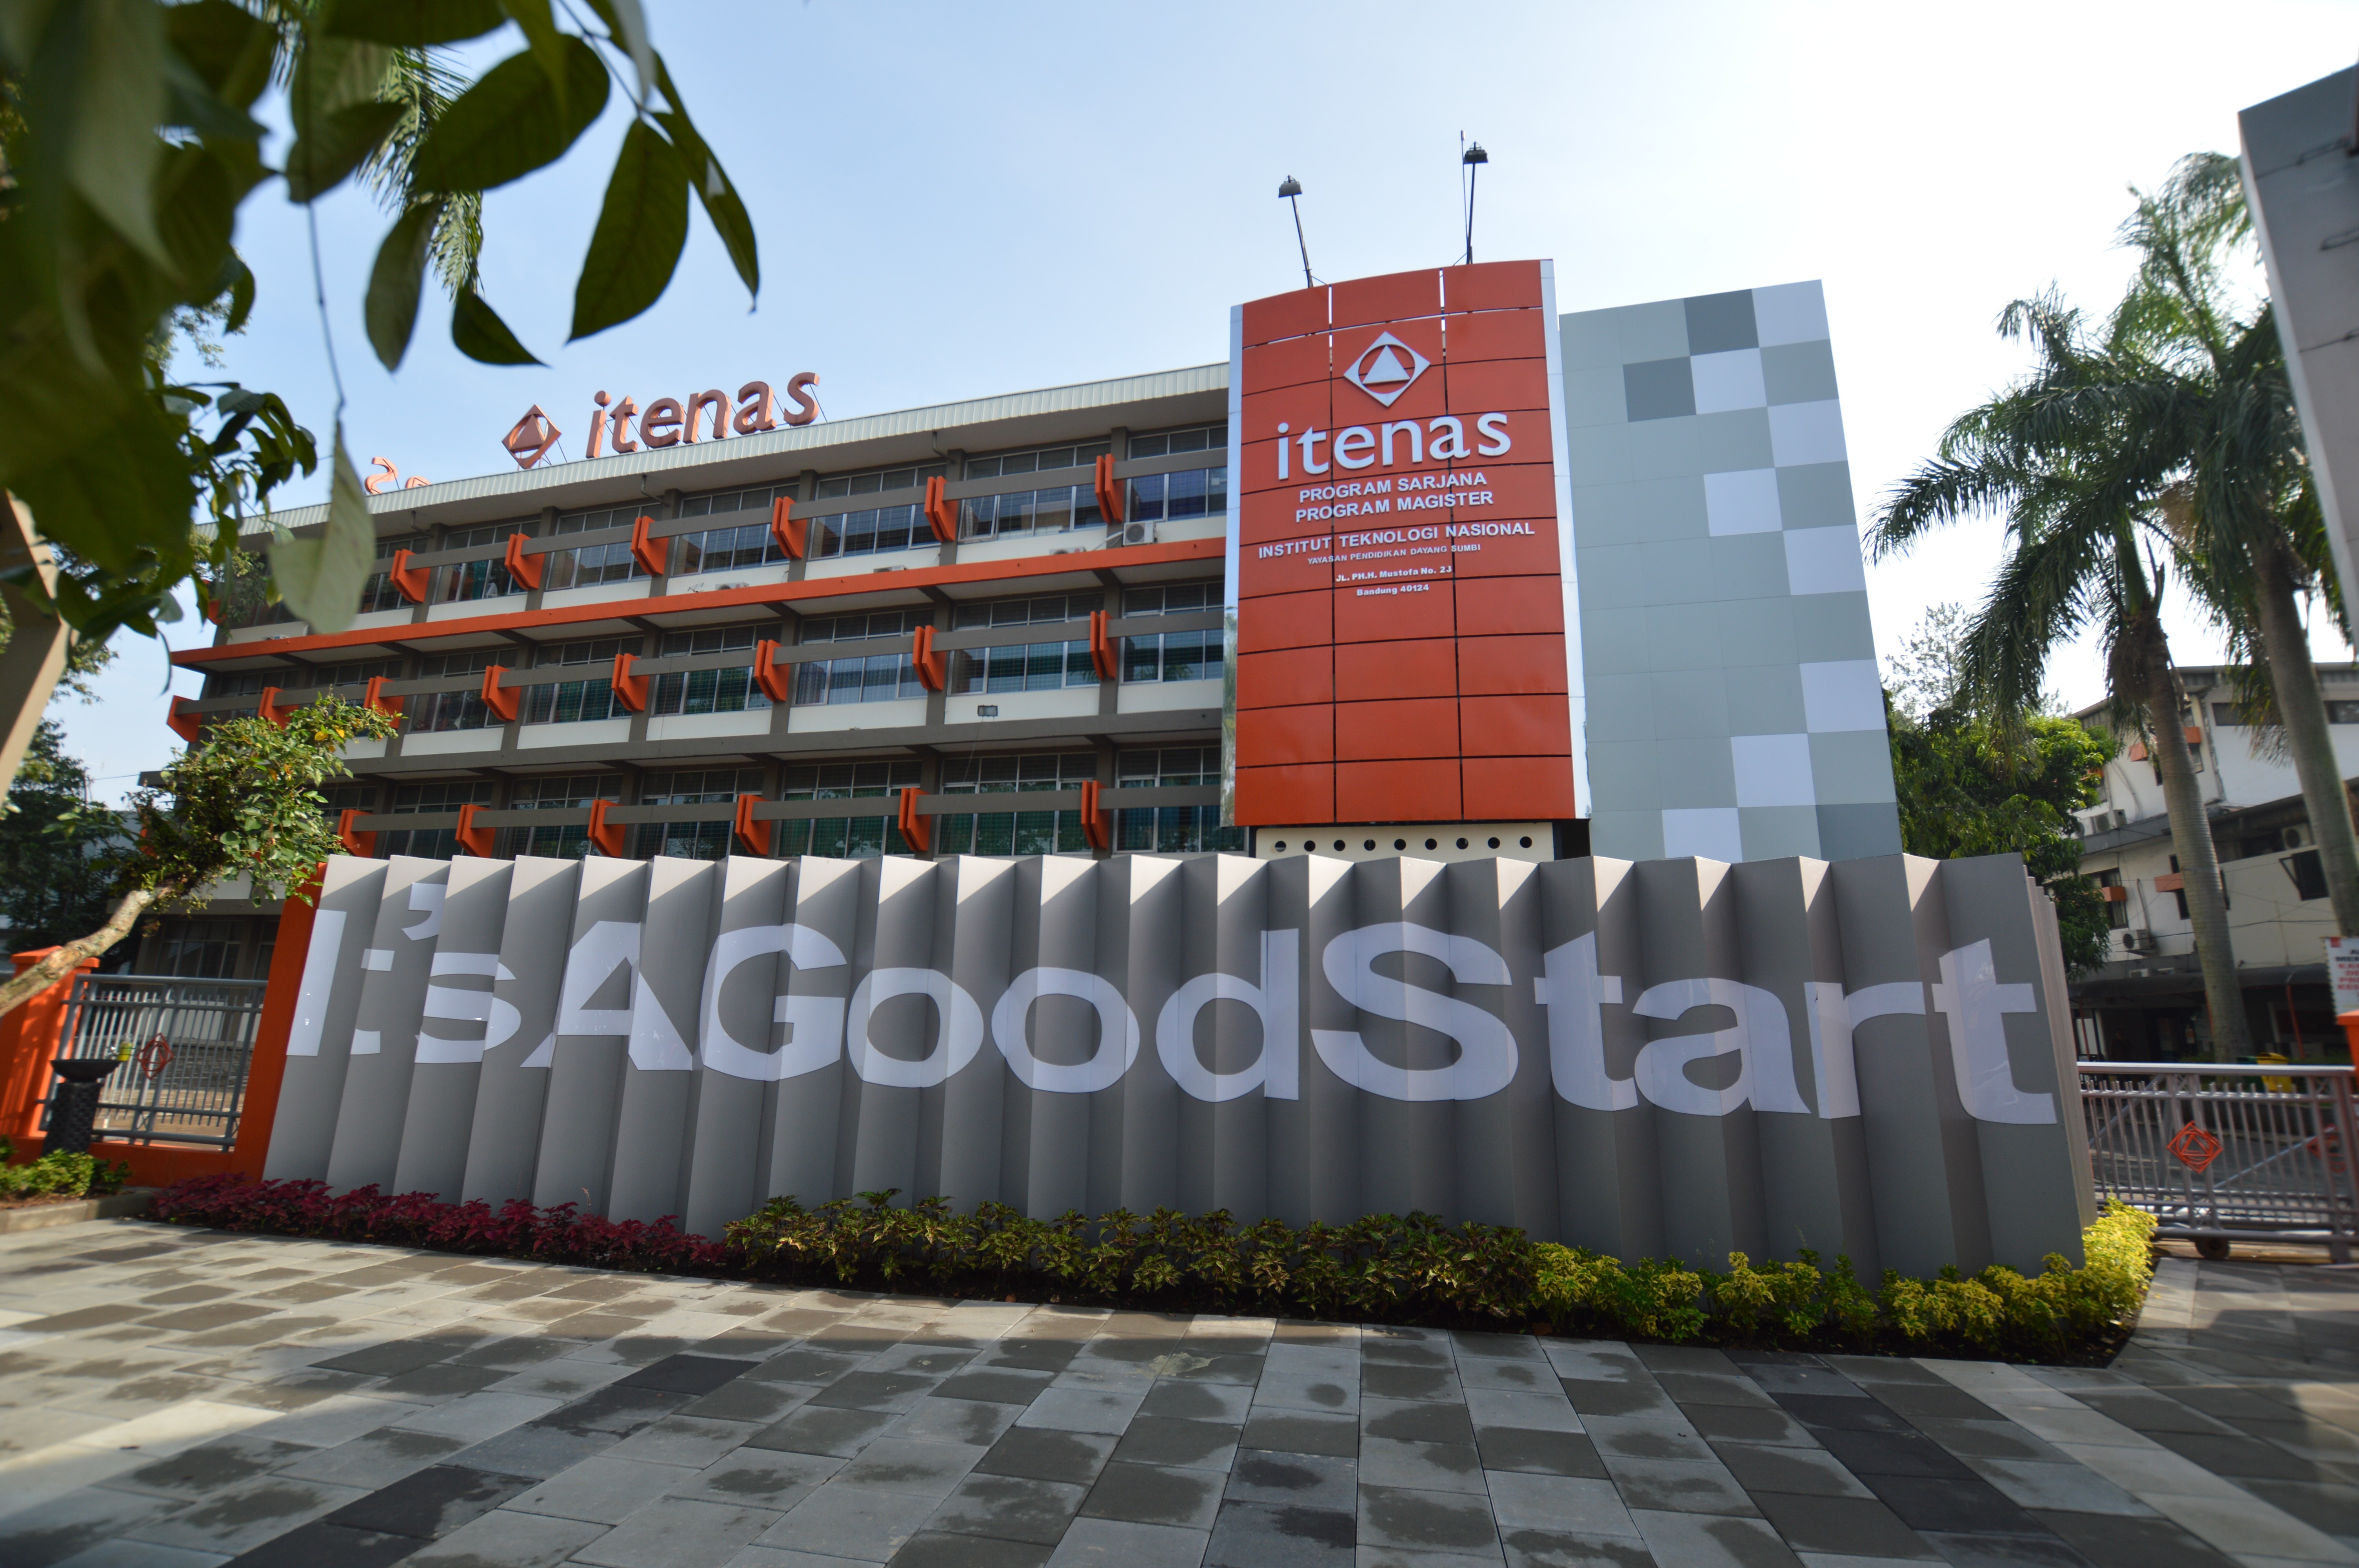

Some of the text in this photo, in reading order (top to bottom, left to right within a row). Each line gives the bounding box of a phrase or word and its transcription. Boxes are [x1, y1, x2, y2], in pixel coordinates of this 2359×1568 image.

[586, 372, 820, 459] itenas
[1278, 413, 1511, 480] itenas
[1299, 472, 1487, 503] PROGRAM SARJANA
[1296, 491, 1494, 523] PROGRAM MAGISTER
[1259, 522, 1535, 559] INSTITUT TEKNOLOGI NASIONAL
[1308, 544, 1481, 564] YAYASAN PENDIDIKAN DAYANG SUMBI
[1352, 572, 1378, 580] PH.H.
[1379, 569, 1419, 577] Mustofa
[1439, 565, 1452, 573] 23
[1357, 584, 1430, 596] Bandung 40124
